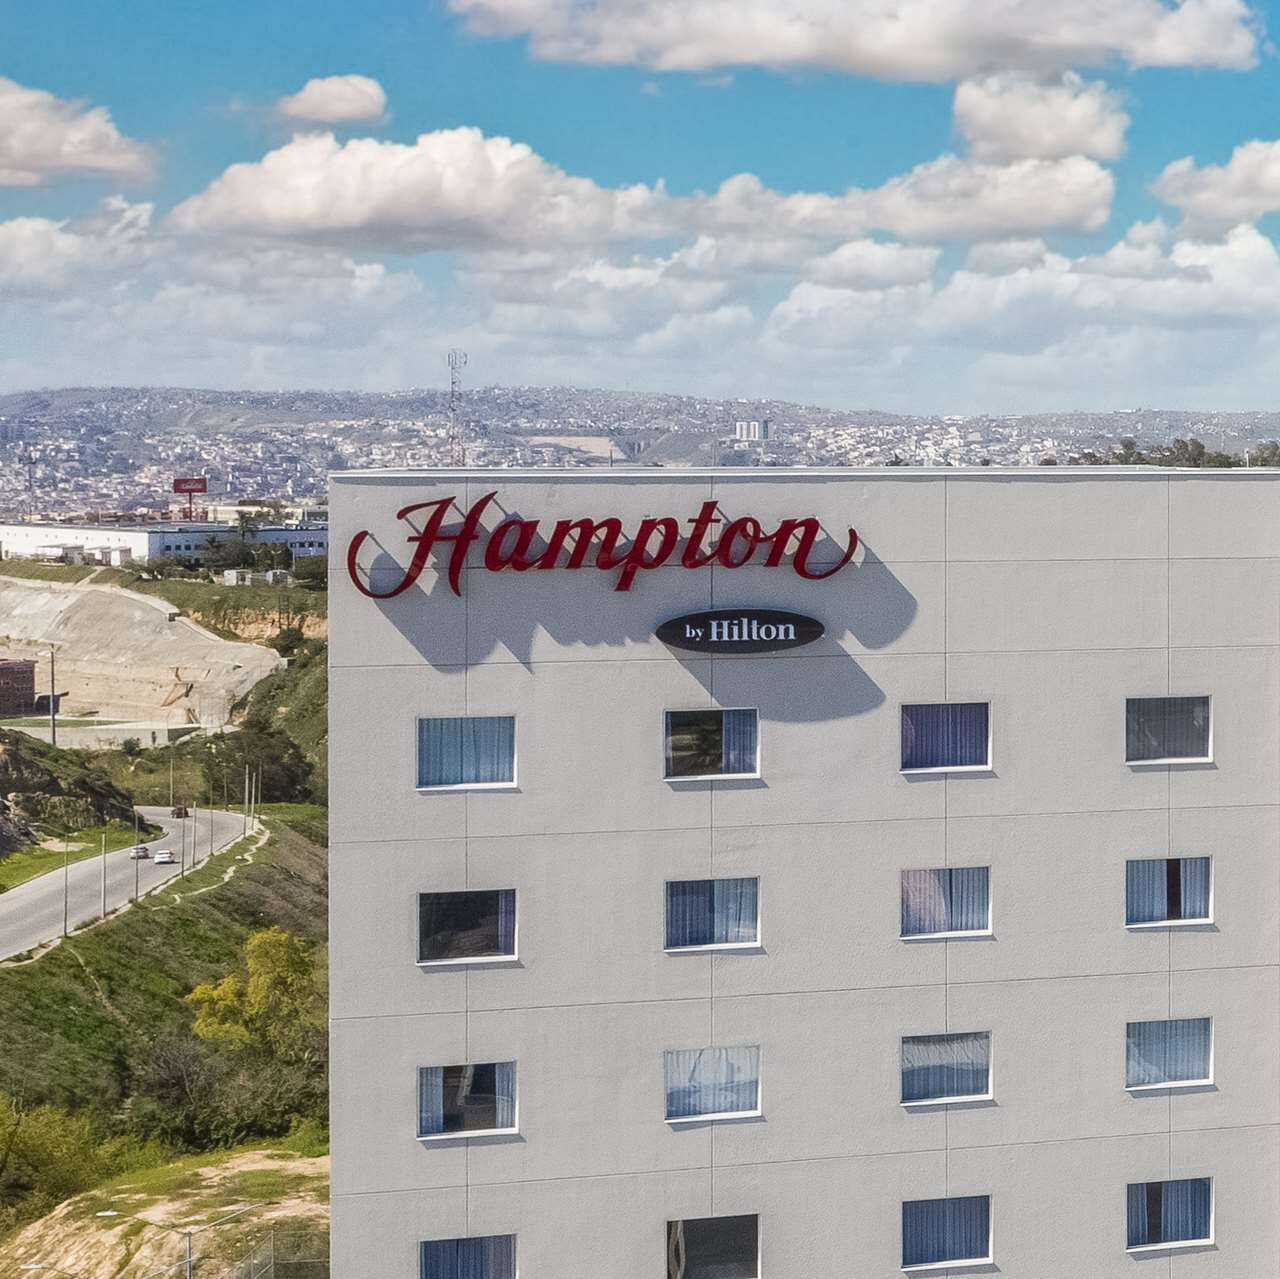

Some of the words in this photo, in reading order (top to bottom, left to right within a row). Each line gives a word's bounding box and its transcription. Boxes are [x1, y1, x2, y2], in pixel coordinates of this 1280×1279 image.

[347, 490, 859, 600] Hampton
[685, 624, 705, 641] by
[708, 618, 797, 642] Hilton
